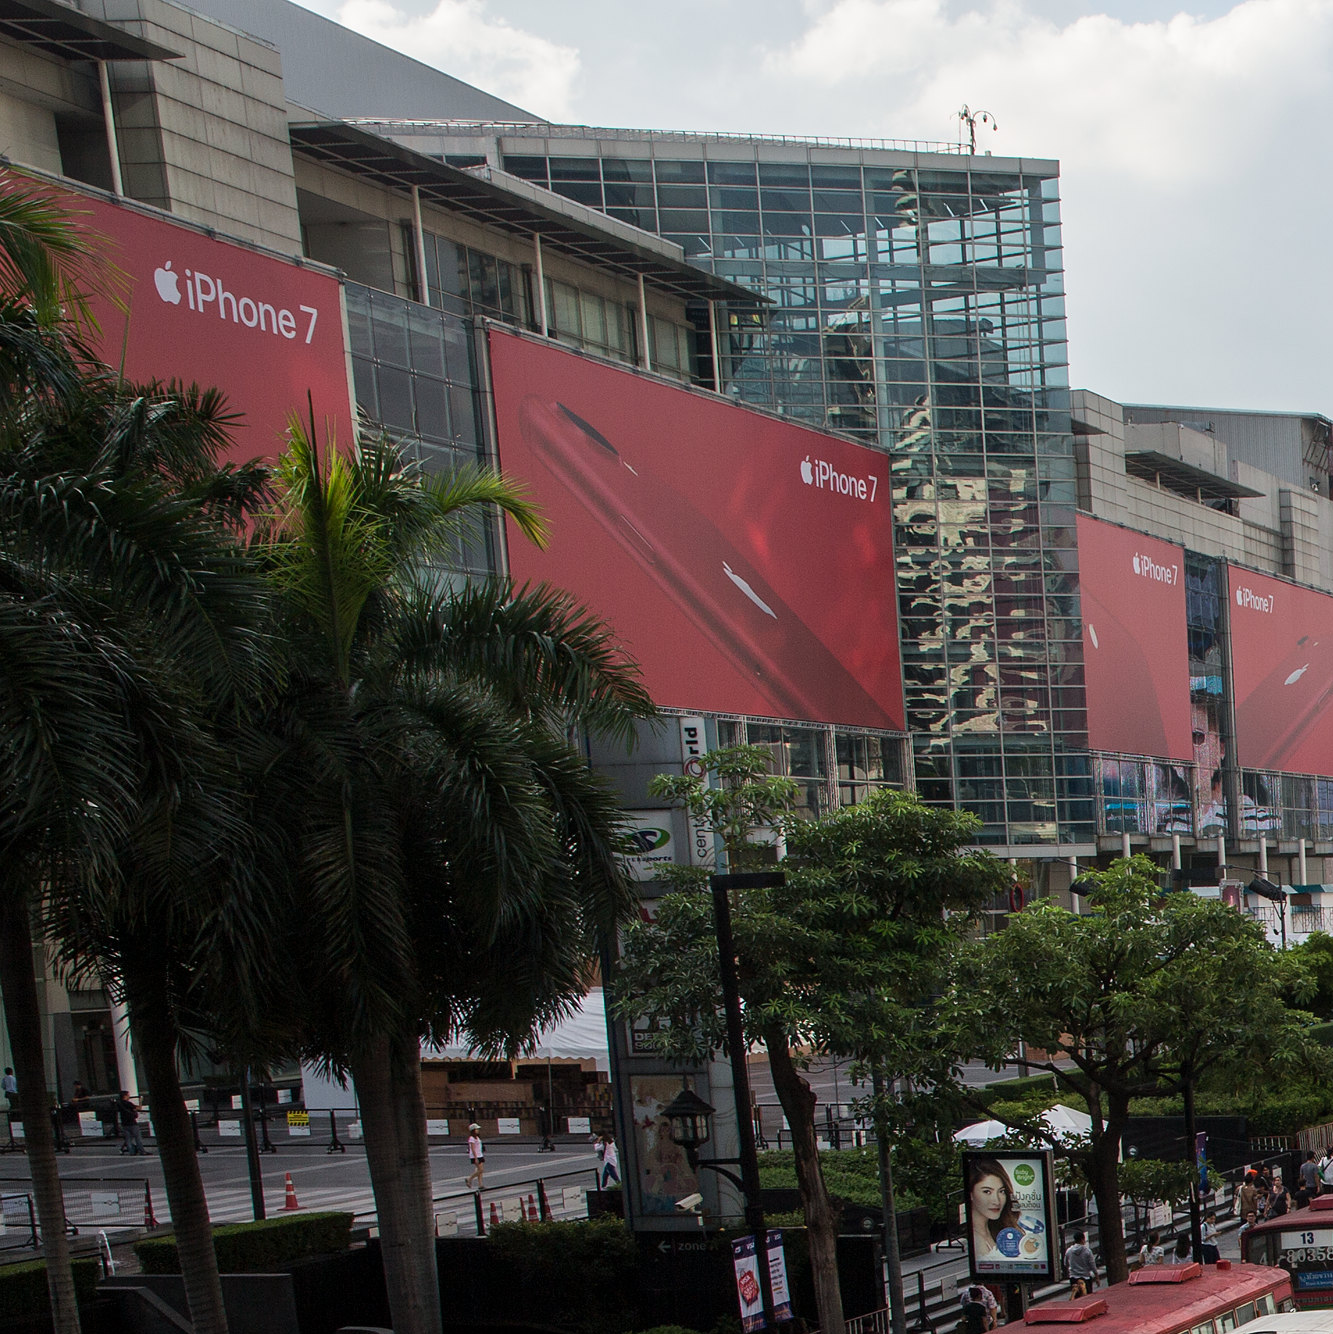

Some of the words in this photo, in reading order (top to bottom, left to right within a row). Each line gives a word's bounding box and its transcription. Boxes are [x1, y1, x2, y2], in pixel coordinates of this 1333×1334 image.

[186, 268, 297, 339] iPhone
[299, 304, 319, 344] 7
[815, 459, 867, 500] iPhone
[868, 475, 878, 502] 7
[1140, 555, 1172, 584] iPhone
[1172, 565, 1178, 586] 7
[1242, 588, 1269, 613] iPhone
[1268, 595, 1274, 614] 7
[678, 1242, 707, 1251] zone
[1300, 1232, 1314, 1245] 13
